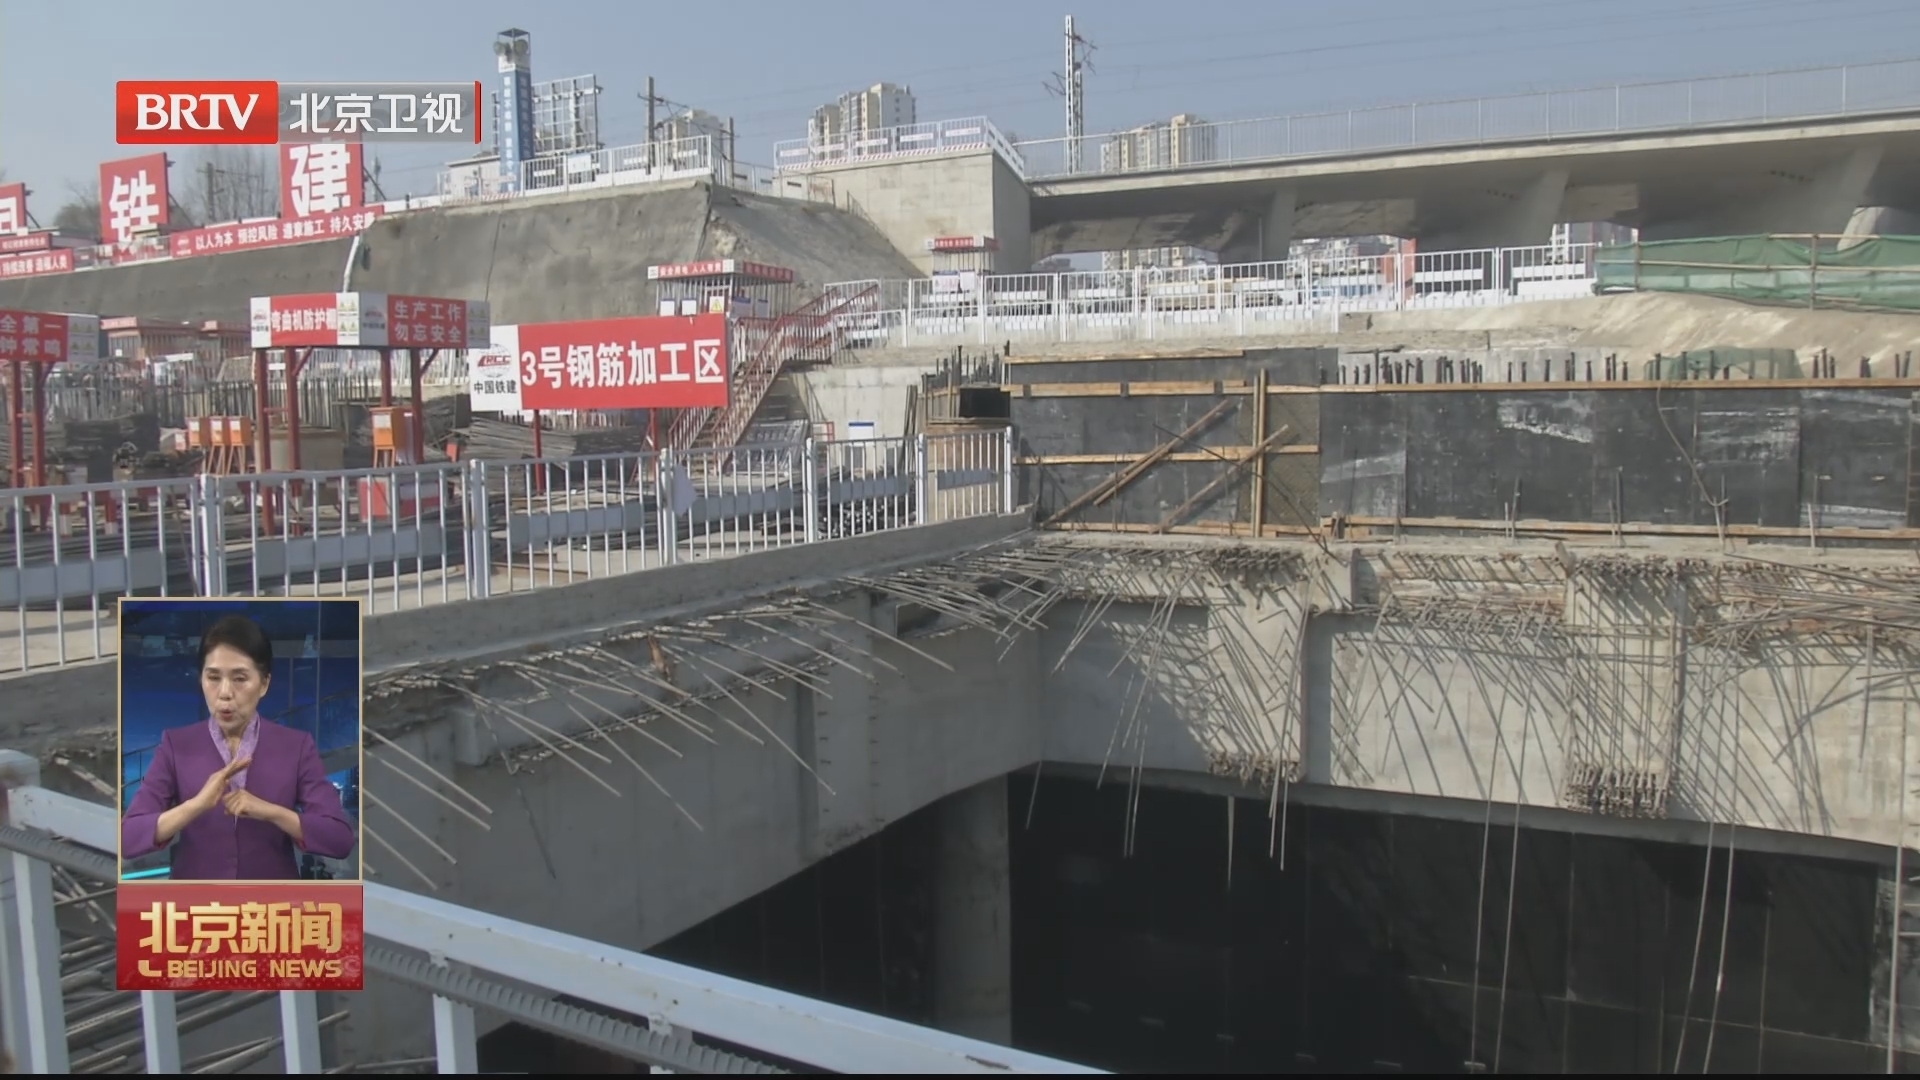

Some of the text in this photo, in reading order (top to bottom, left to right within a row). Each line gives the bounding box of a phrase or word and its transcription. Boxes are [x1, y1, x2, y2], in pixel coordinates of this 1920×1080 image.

[289, 138, 352, 217] 建
[195, 232, 234, 251] 以人为本
[238, 226, 279, 245] 预控风险
[271, 308, 338, 335] 弯曲机防护棚
[394, 301, 462, 321] 生产工作
[394, 324, 462, 343] 勿忘安全
[521, 338, 724, 390] 3号钢筋加工区
[473, 379, 518, 396] 中国铁建
